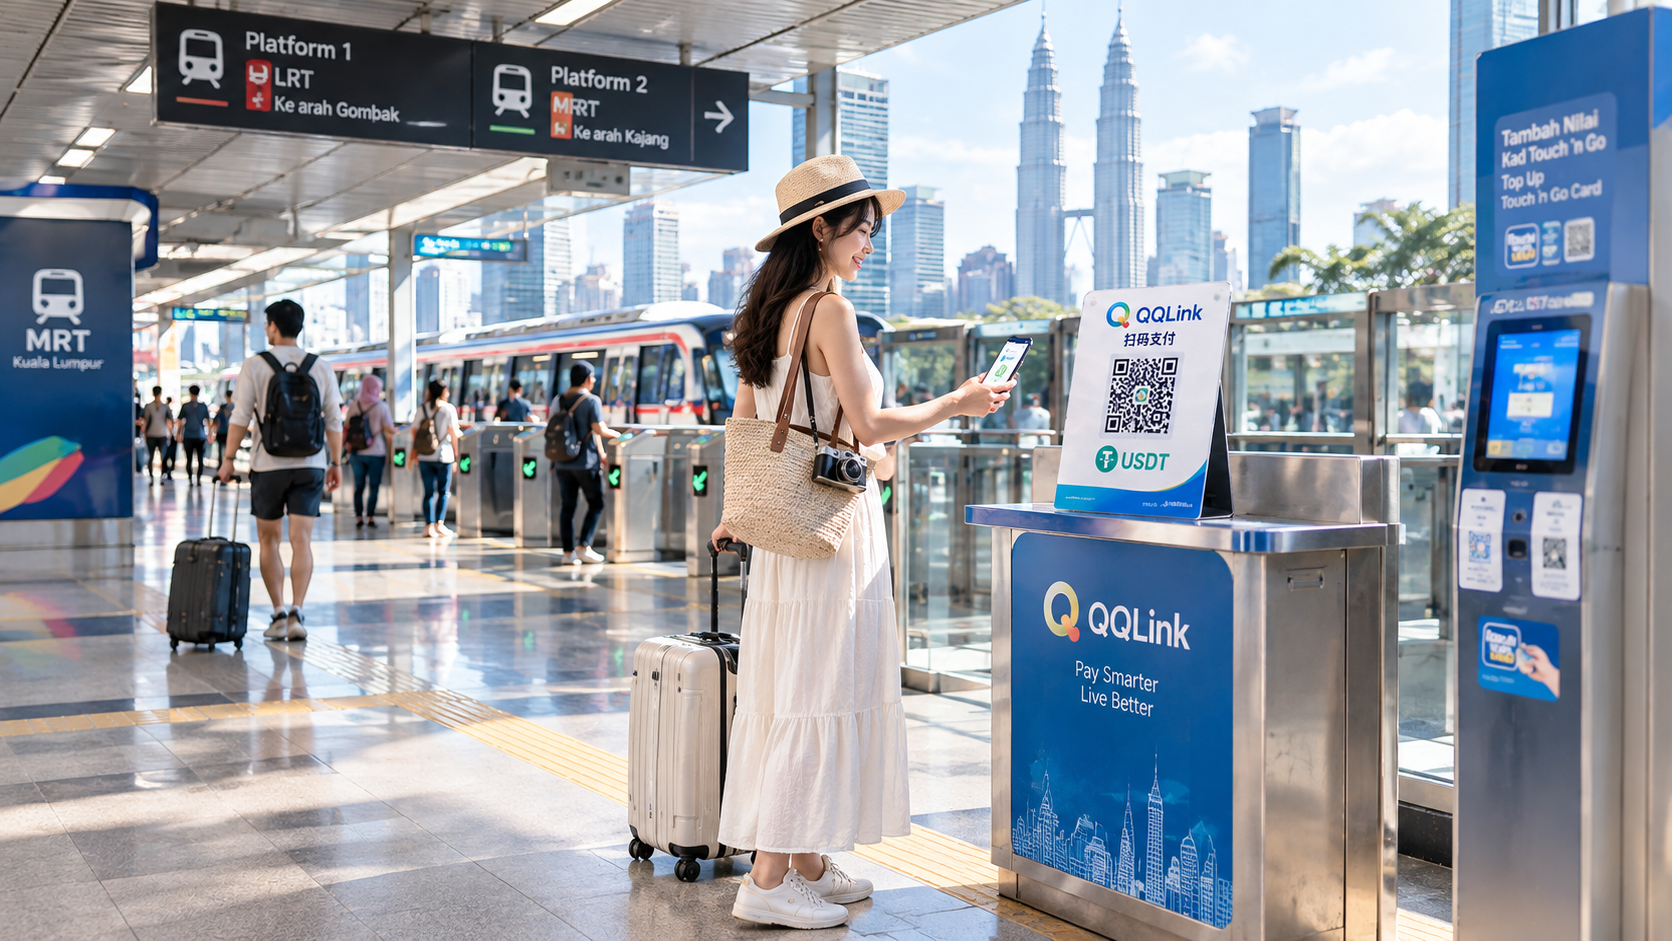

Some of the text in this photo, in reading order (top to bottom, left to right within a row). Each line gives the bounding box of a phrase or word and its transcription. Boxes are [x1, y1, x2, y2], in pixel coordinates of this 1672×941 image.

[246, 31, 351, 61] Platform 1
[274, 67, 314, 89] LRT
[551, 65, 648, 94] Platform 2
[274, 95, 400, 123] Ke arah Gombak
[573, 124, 669, 150] Ke arah Kajang
[1501, 108, 1599, 147] Tambah Nilai
[1501, 147, 1526, 168] Kad
[1528, 139, 1569, 163] Touch
[1585, 133, 1607, 152] Go
[1501, 170, 1545, 192] Top Up
[1501, 191, 1535, 210] Touch
[1549, 186, 1569, 202] Go
[1570, 179, 1603, 199] Card
[1136, 303, 1203, 324] QQLink
[25, 327, 92, 353] MRT
[1123, 330, 1176, 347] 扫码支付
[12, 355, 105, 372] Kuala Lumpur
[1121, 451, 1170, 471] USDT
[1088, 601, 1191, 650] QQLink
[1075, 660, 1159, 693] Pay Smarter
[1081, 684, 1154, 717] Live Better
